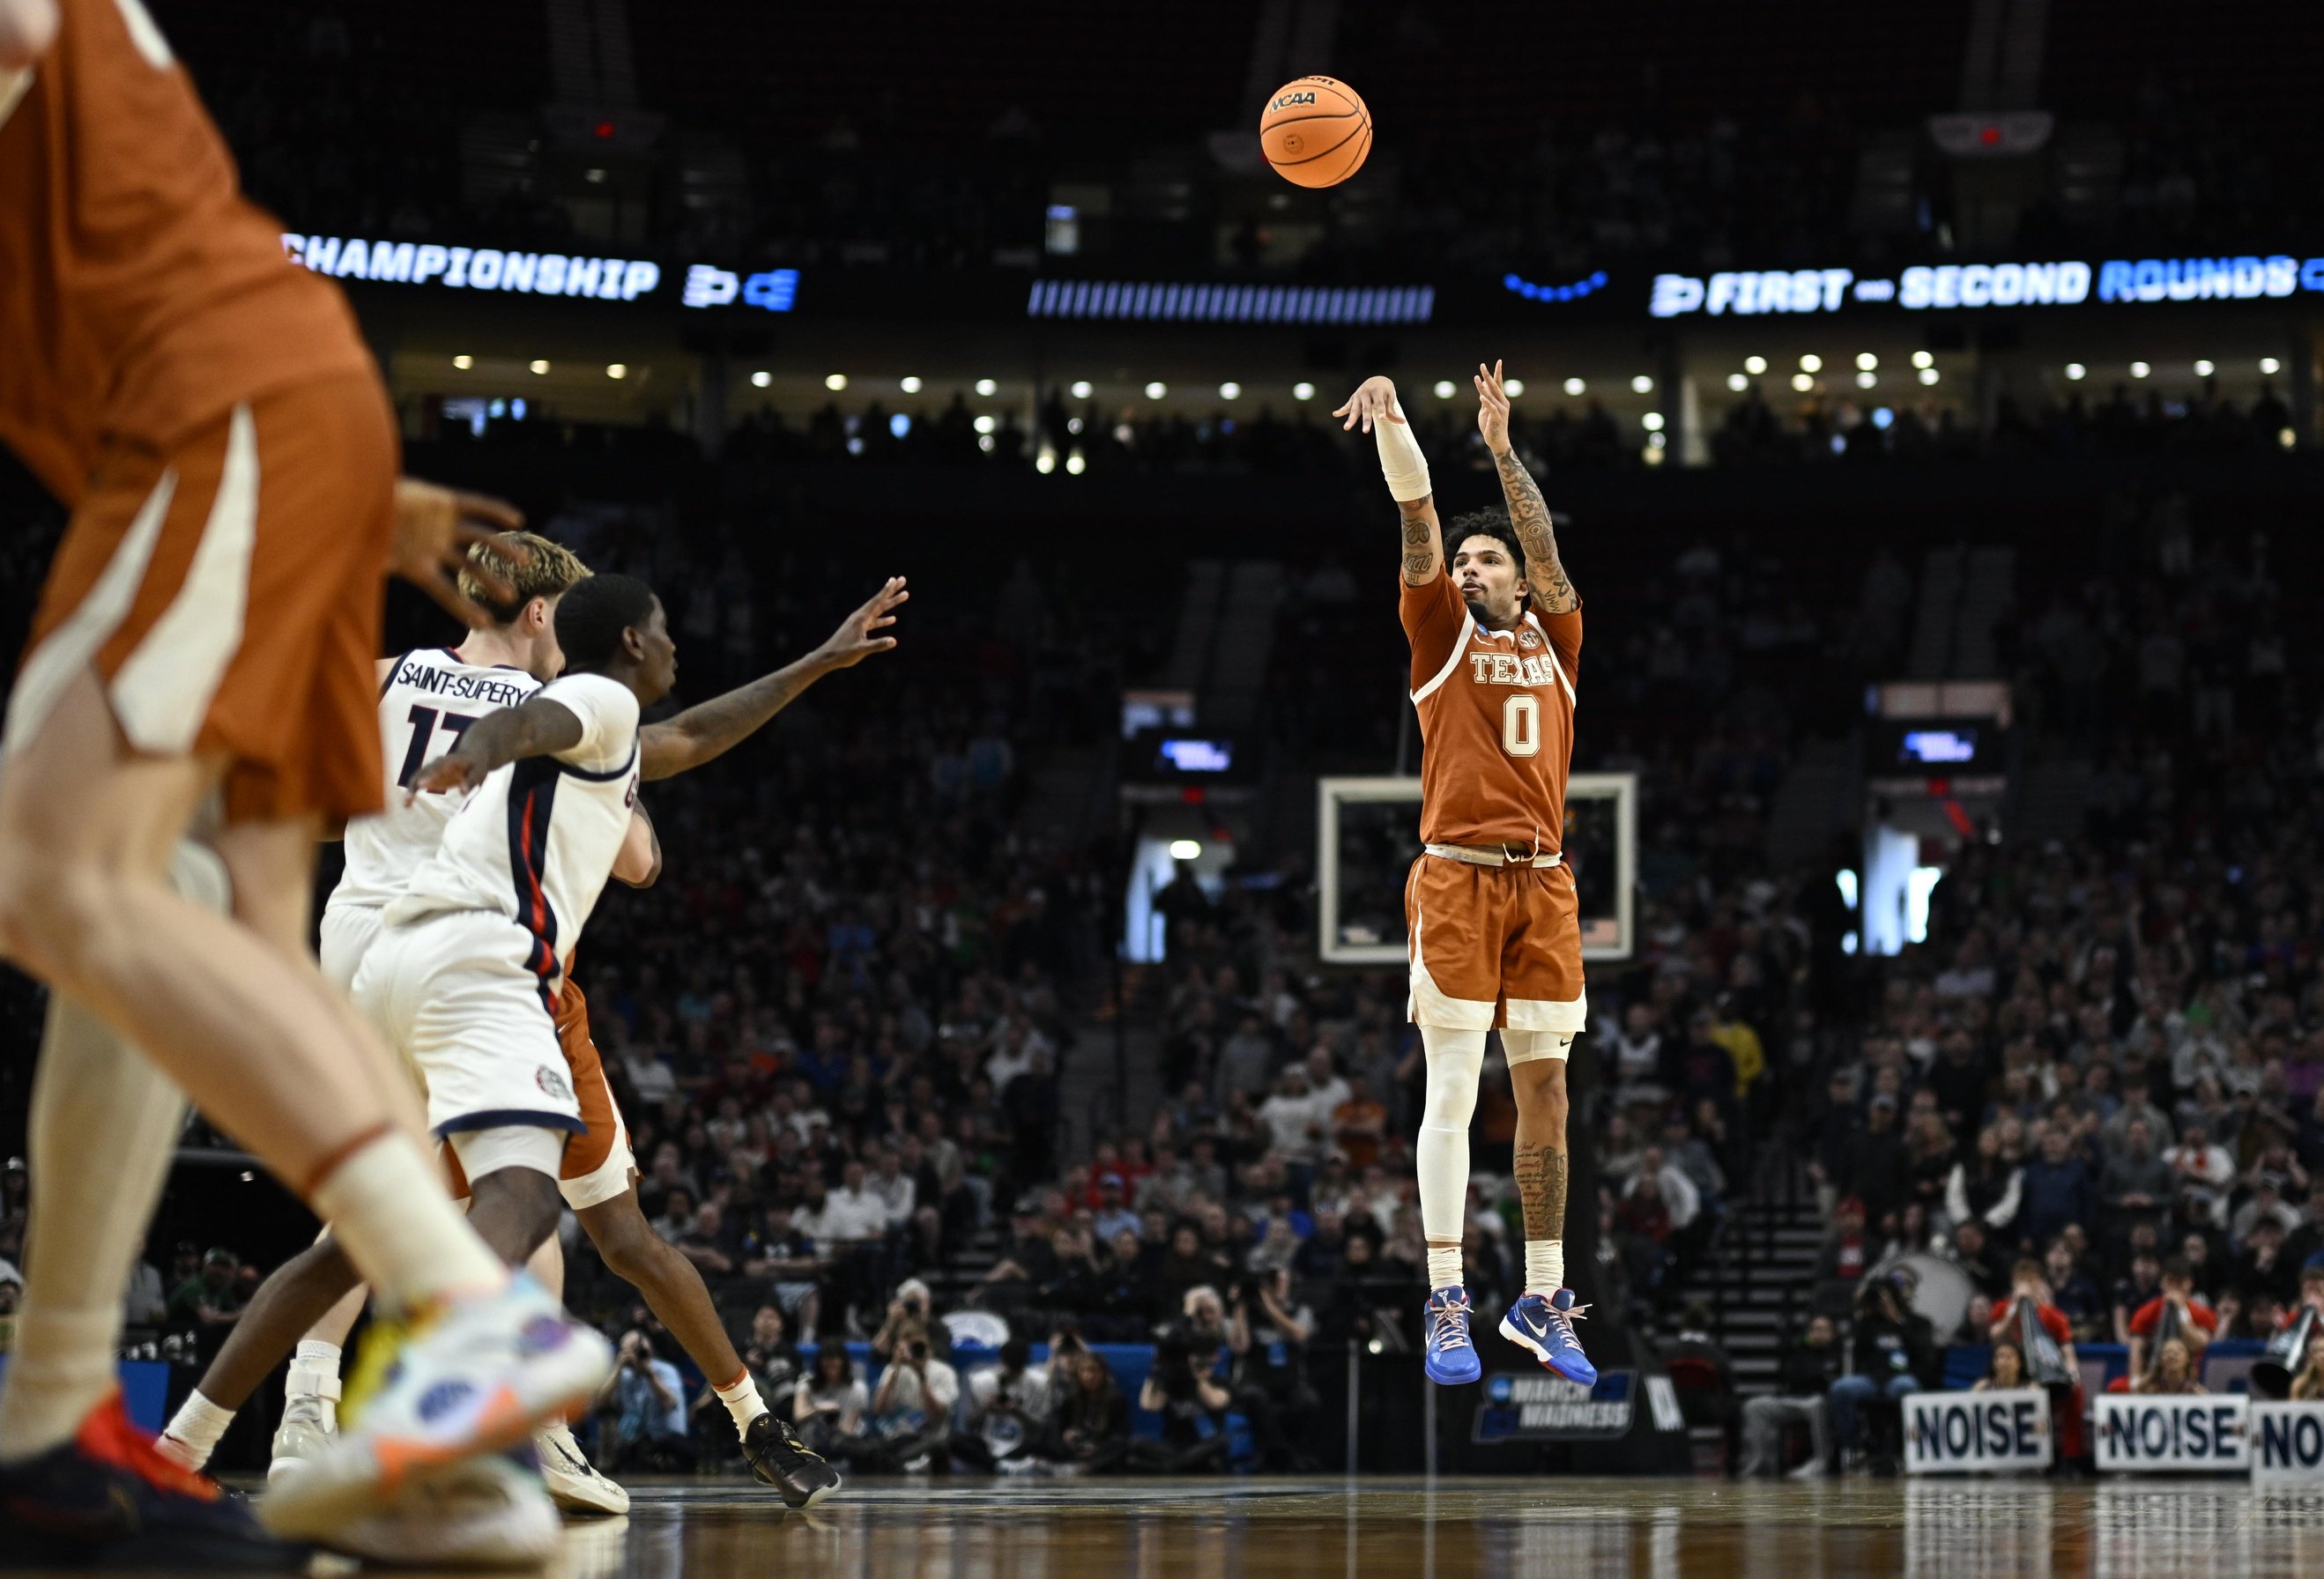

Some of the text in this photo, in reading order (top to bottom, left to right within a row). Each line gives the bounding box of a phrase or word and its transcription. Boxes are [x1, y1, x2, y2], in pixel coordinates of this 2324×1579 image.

[1269, 92, 1316, 114] NCAA
[280, 234, 660, 300] CHAMPIONSHIP
[1706, 268, 1853, 315] FIRST
[1899, 262, 2091, 308] SECOND
[2098, 256, 2296, 303] ROUNDS
[1470, 652, 1554, 686] TEXAS
[1503, 694, 1541, 758] 0
[1916, 1402, 2038, 1461] NOISE
[2262, 1413, 2323, 1468] NO
